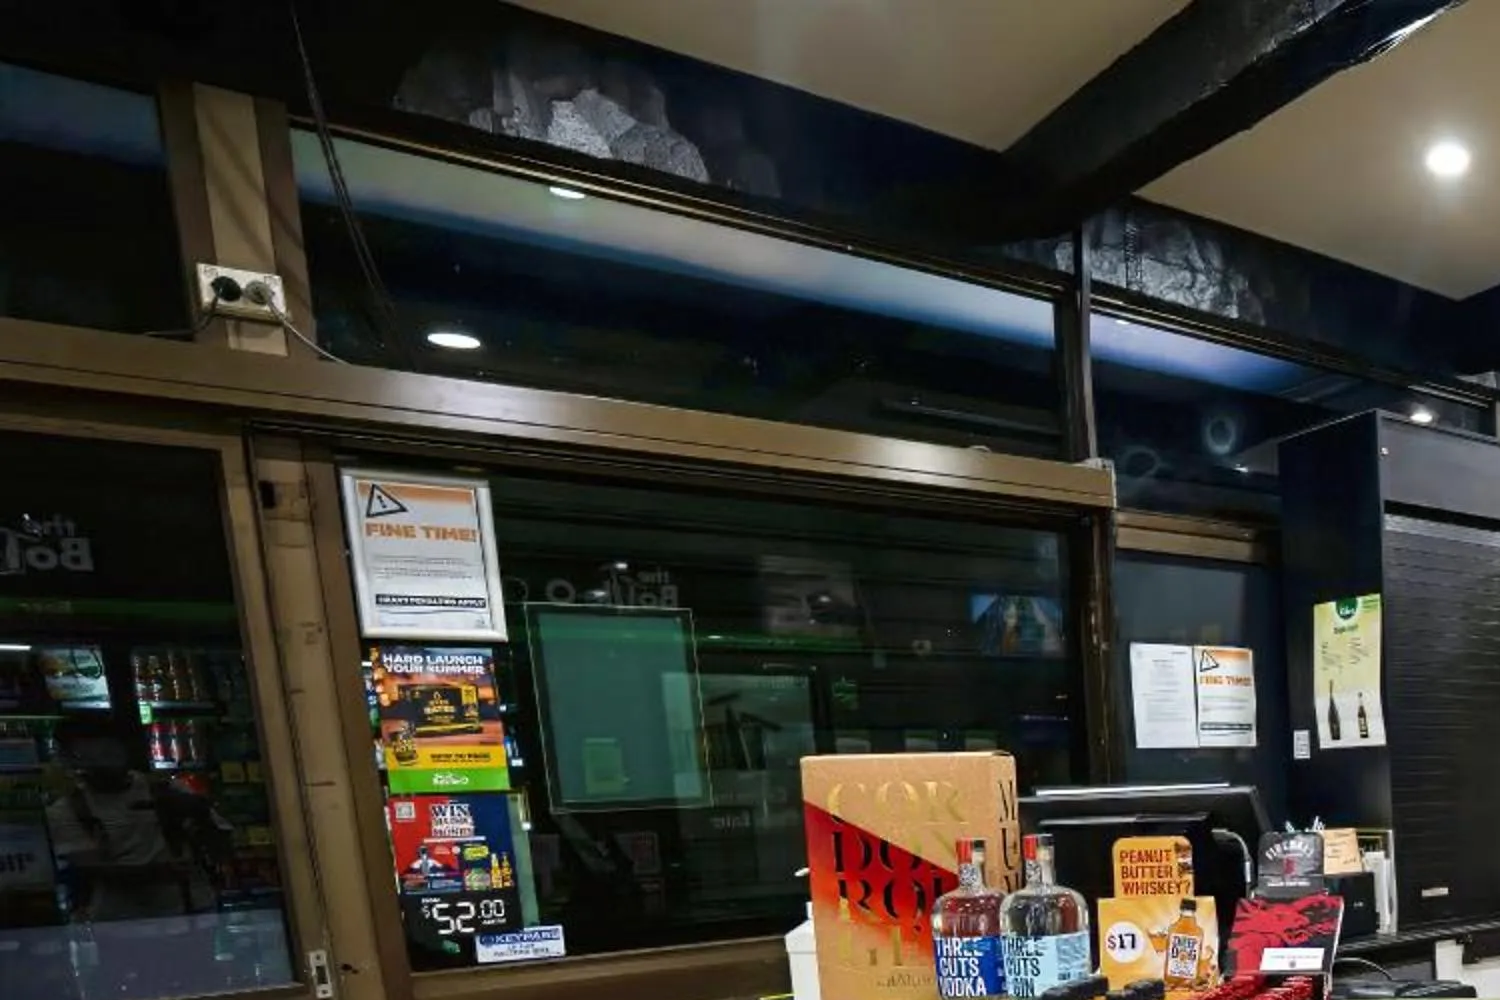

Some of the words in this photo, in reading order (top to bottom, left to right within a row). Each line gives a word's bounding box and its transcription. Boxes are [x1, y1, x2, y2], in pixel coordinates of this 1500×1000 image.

[366, 523, 416, 538] FINE
[421, 526, 477, 542] TIME!
[383, 654, 423, 664] HARD
[426, 655, 482, 665] LAUNCH
[384, 664, 422, 673] YOUR
[1120, 849, 1172, 864] PEANUT
[1121, 865, 1173, 880] BUTTER
[1122, 880, 1191, 896] WHISKEY?
[936, 937, 983, 958] THREE
[1001, 938, 1044, 958] THREE
[1107, 934, 1136, 950] $17
[938, 977, 988, 997] VODKA
[1012, 978, 1035, 999] GIN
